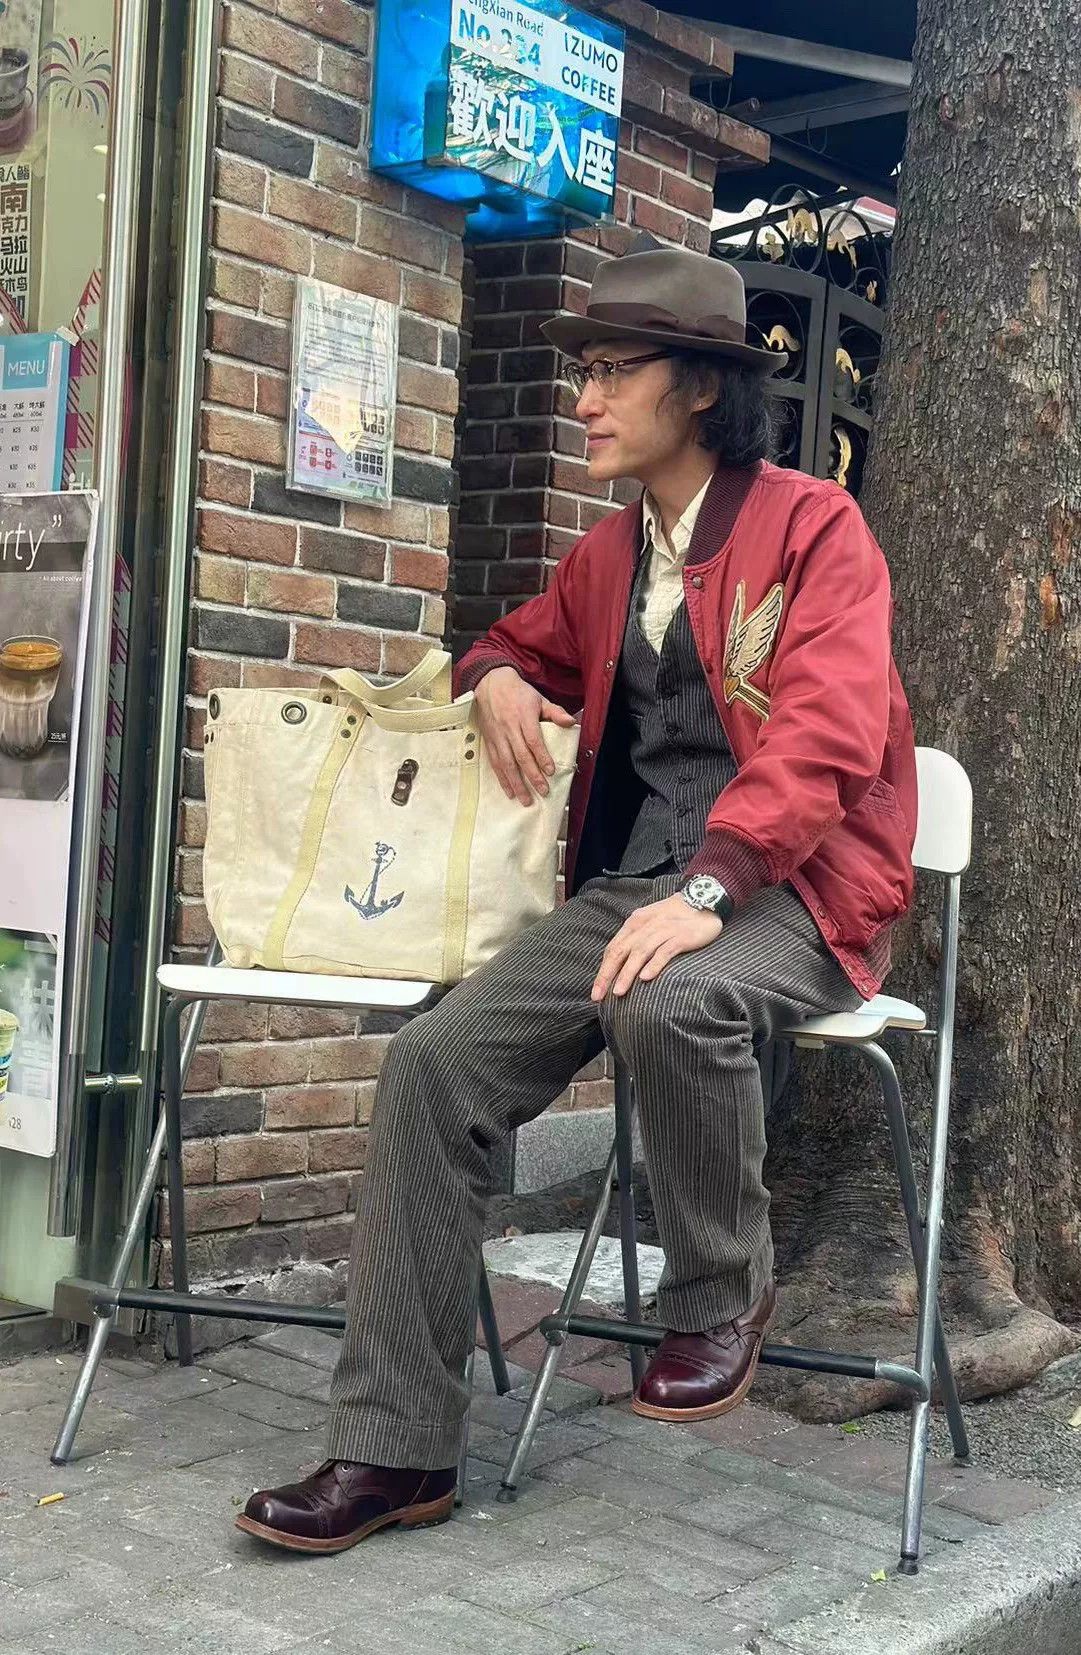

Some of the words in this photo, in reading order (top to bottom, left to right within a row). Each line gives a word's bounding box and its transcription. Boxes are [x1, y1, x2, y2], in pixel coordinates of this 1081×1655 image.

[516, 12, 544, 37] Road
[564, 32, 618, 73] IZUMO
[561, 66, 616, 106] COFFEE
[451, 69, 616, 196] 歡迎入座
[7, 360, 46, 377] MENU
